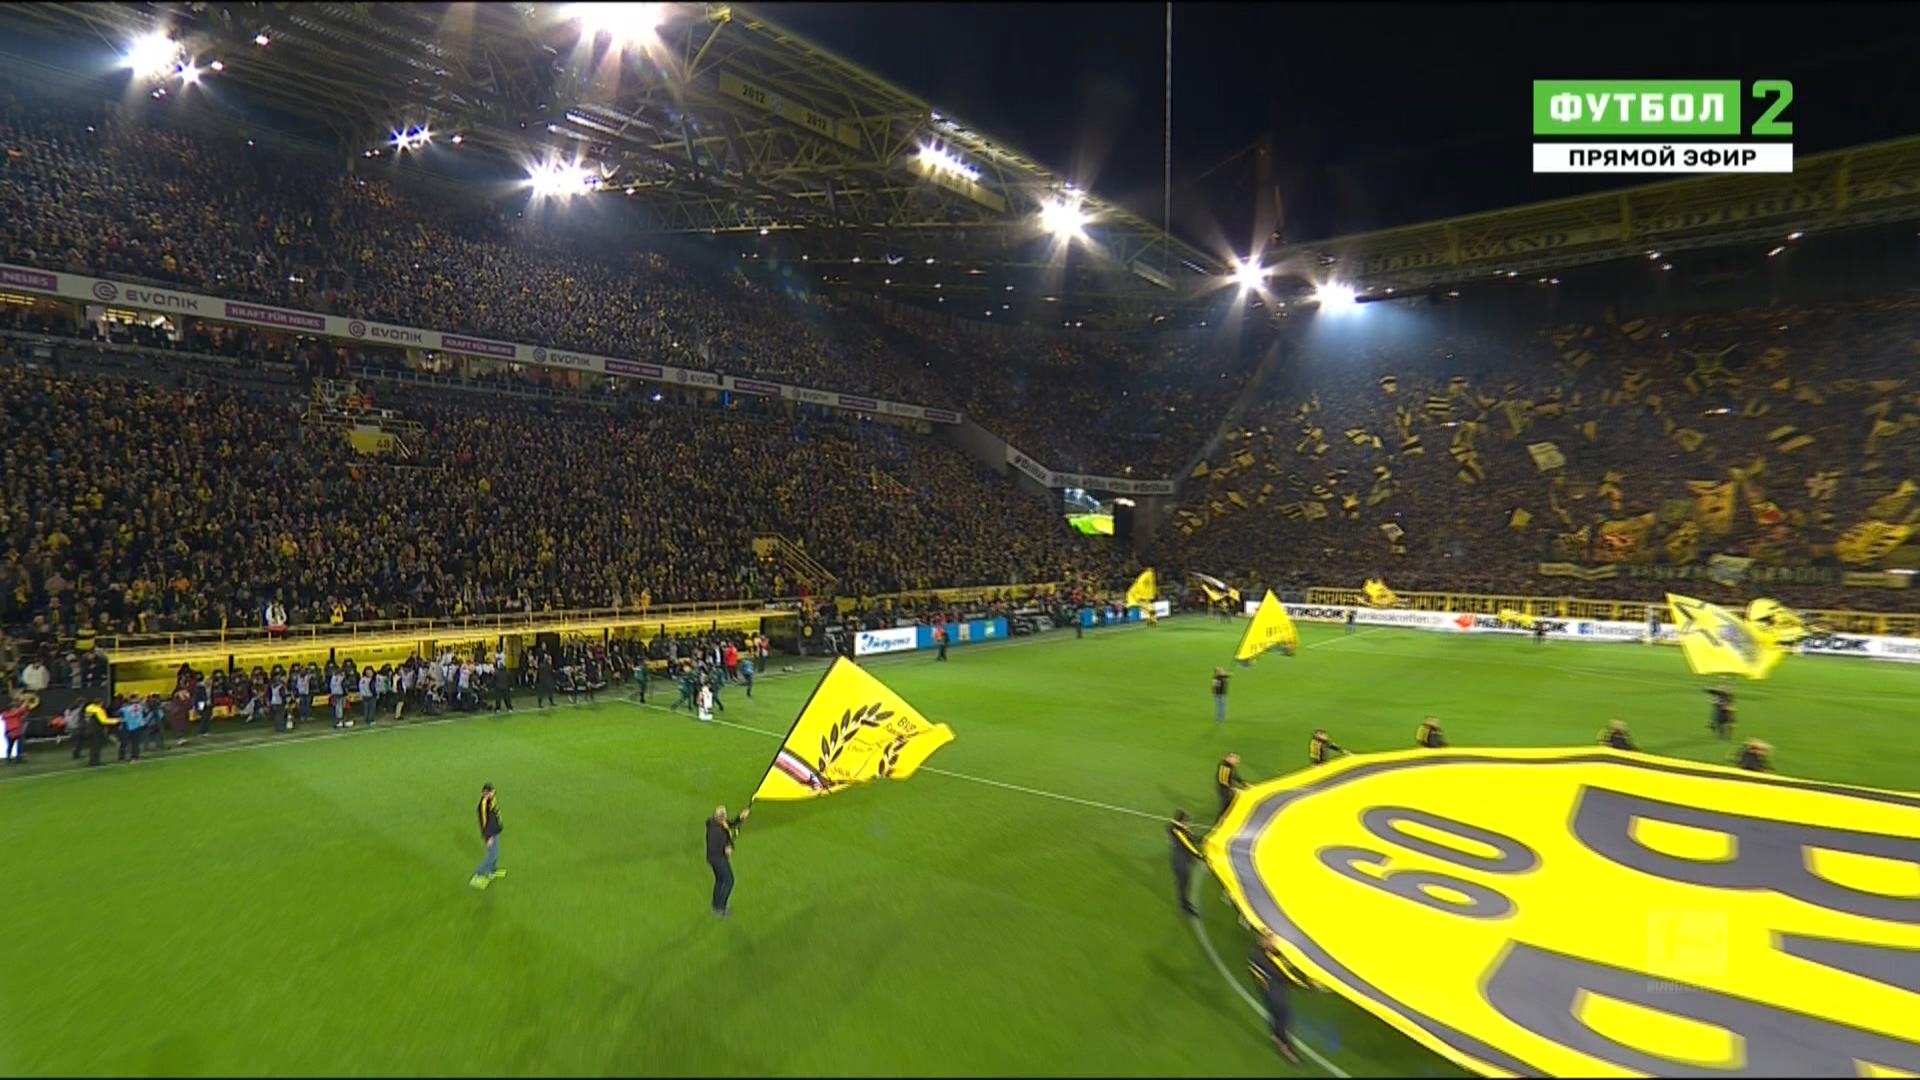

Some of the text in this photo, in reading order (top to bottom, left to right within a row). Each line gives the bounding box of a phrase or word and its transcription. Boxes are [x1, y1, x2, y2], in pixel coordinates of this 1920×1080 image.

[742, 84, 765, 103] 2012
[807, 113, 826, 130] 2012
[3, 270, 49, 287] NEUES
[125, 289, 199, 311] EVONIK
[230, 306, 264, 322] KRAFT
[288, 316, 321, 329] NEUES
[371, 327, 422, 343] EVONIK
[550, 353, 591, 367] EVONIK
[690, 374, 717, 387] EVONI
[1314, 804, 1543, 921] 09
